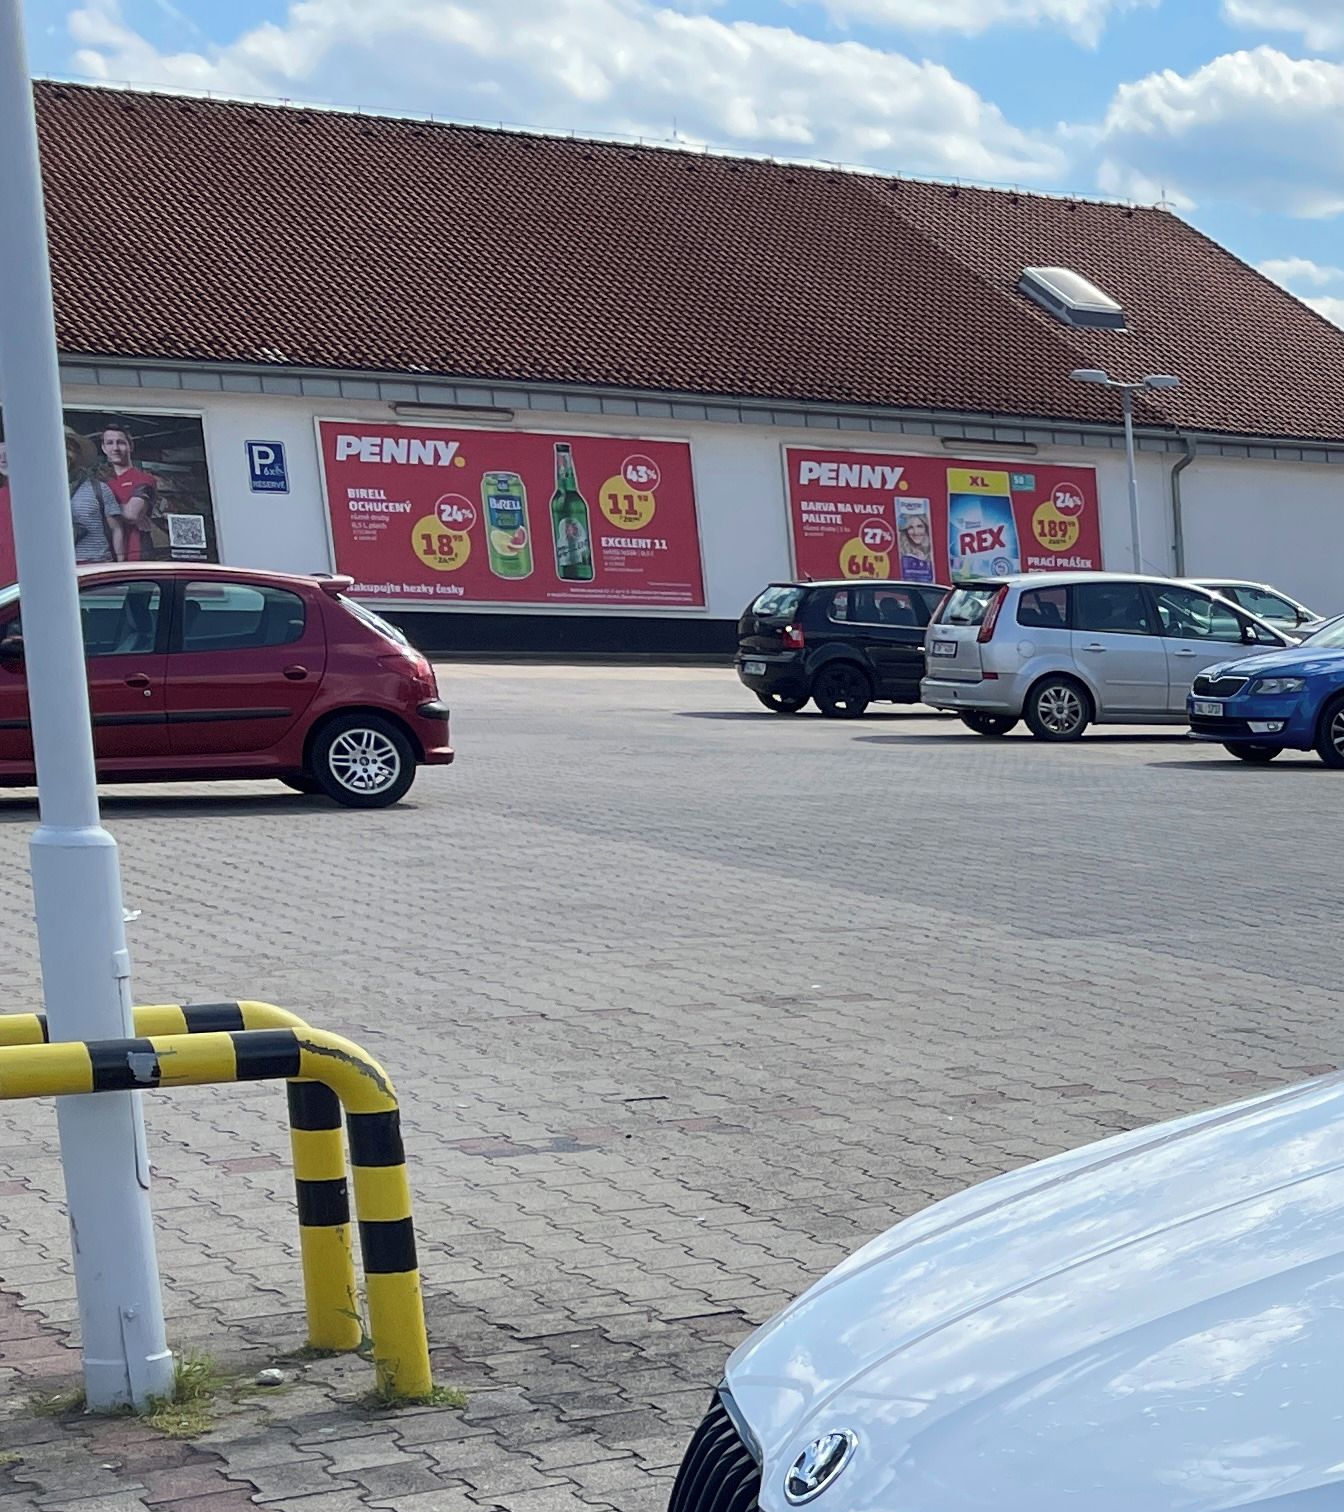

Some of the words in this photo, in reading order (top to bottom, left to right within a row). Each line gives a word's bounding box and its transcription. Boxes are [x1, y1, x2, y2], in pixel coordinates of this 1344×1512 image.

[252, 445, 275, 475] P
[969, 475, 990, 487] XL
[347, 488, 387, 500] BIRELL
[348, 500, 412, 513] OCHUCENÝ
[801, 501, 836, 512] BARVA
[838, 503, 852, 513] NA
[854, 504, 885, 515] VLASY
[802, 513, 842, 524] PALETTE
[601, 537, 651, 549] EXCELENT
[960, 525, 1005, 555] REX
[403, 583, 434, 595] hezky
